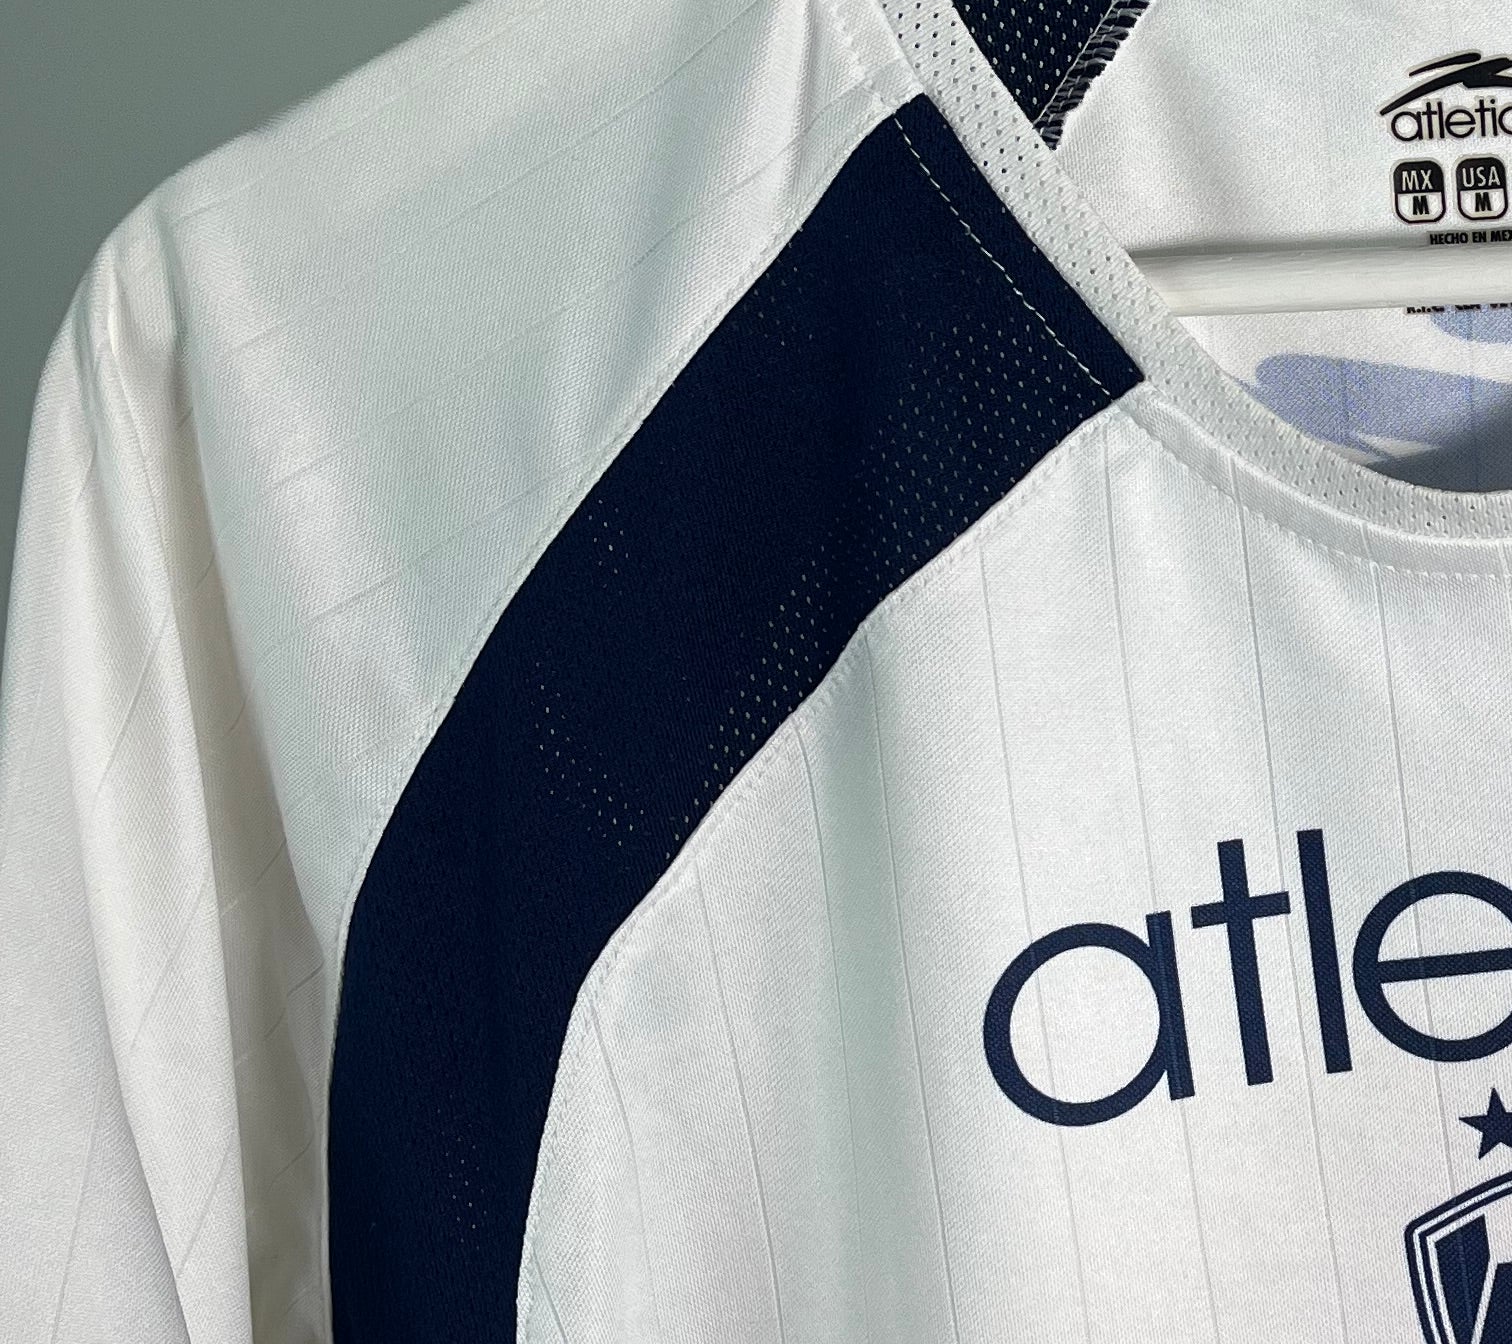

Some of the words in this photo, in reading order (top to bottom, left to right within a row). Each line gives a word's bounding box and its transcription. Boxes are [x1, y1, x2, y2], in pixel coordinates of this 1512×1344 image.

[1401, 169, 1434, 191] MX
[1461, 166, 1500, 188] USA
[1412, 195, 1430, 216] M
[1474, 191, 1493, 212] M
[1429, 231, 1469, 246] HECHO
[1472, 230, 1488, 244] EN
